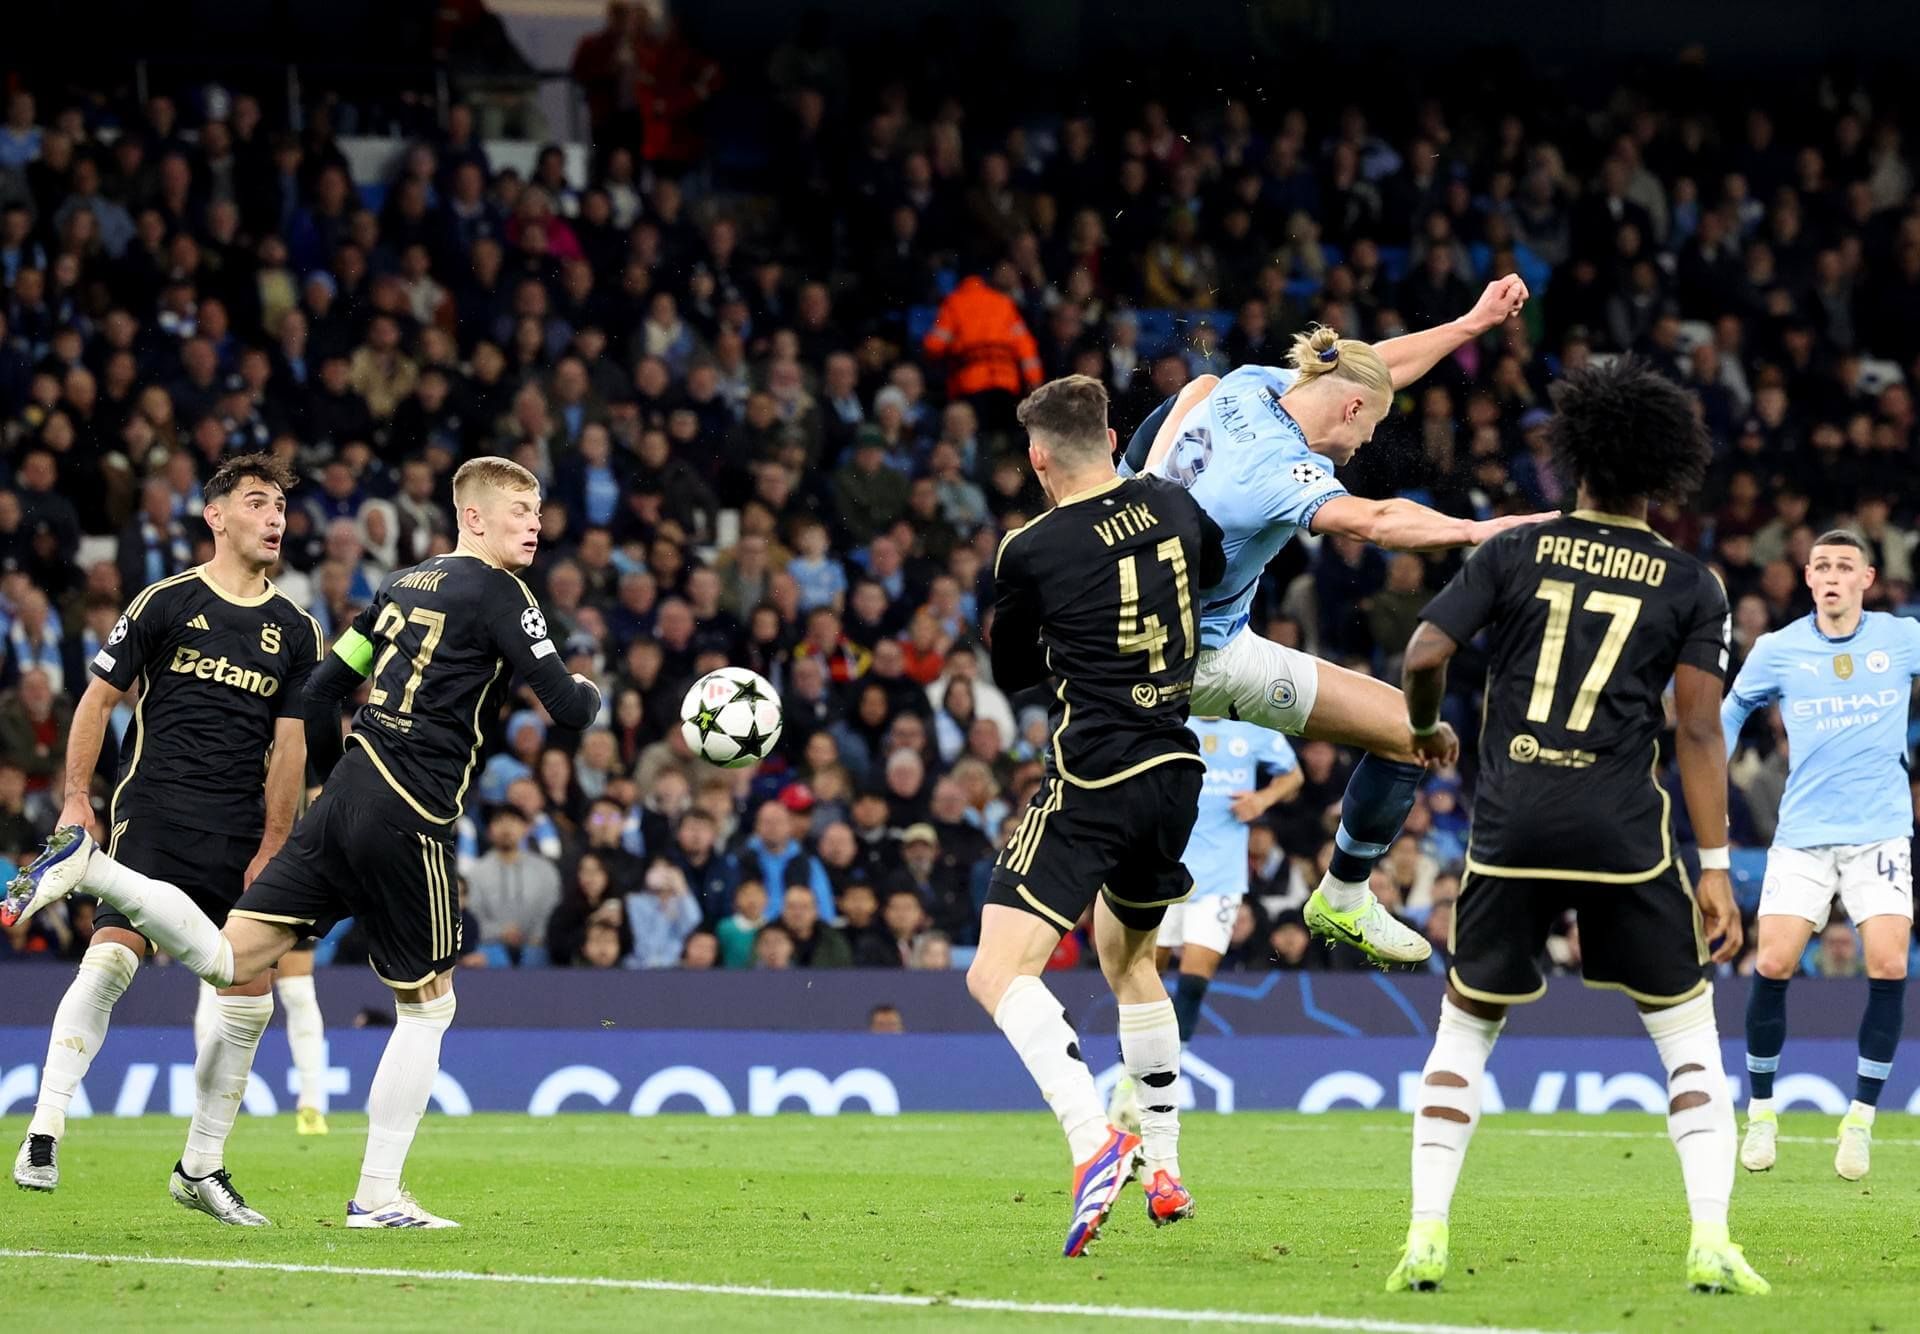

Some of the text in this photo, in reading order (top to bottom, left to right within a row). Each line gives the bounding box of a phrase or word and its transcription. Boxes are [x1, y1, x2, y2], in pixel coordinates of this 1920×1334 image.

[1094, 502, 1159, 547] VITÍK
[1535, 535, 1667, 587] PRECIADO
[1117, 536, 1194, 674] 41
[170, 646, 279, 697] Betano
[368, 601, 447, 713] 27
[1526, 578, 1643, 732] 17
[1793, 688, 1899, 717] ETIHAD
[1816, 711, 1879, 732] AIRWAYS
